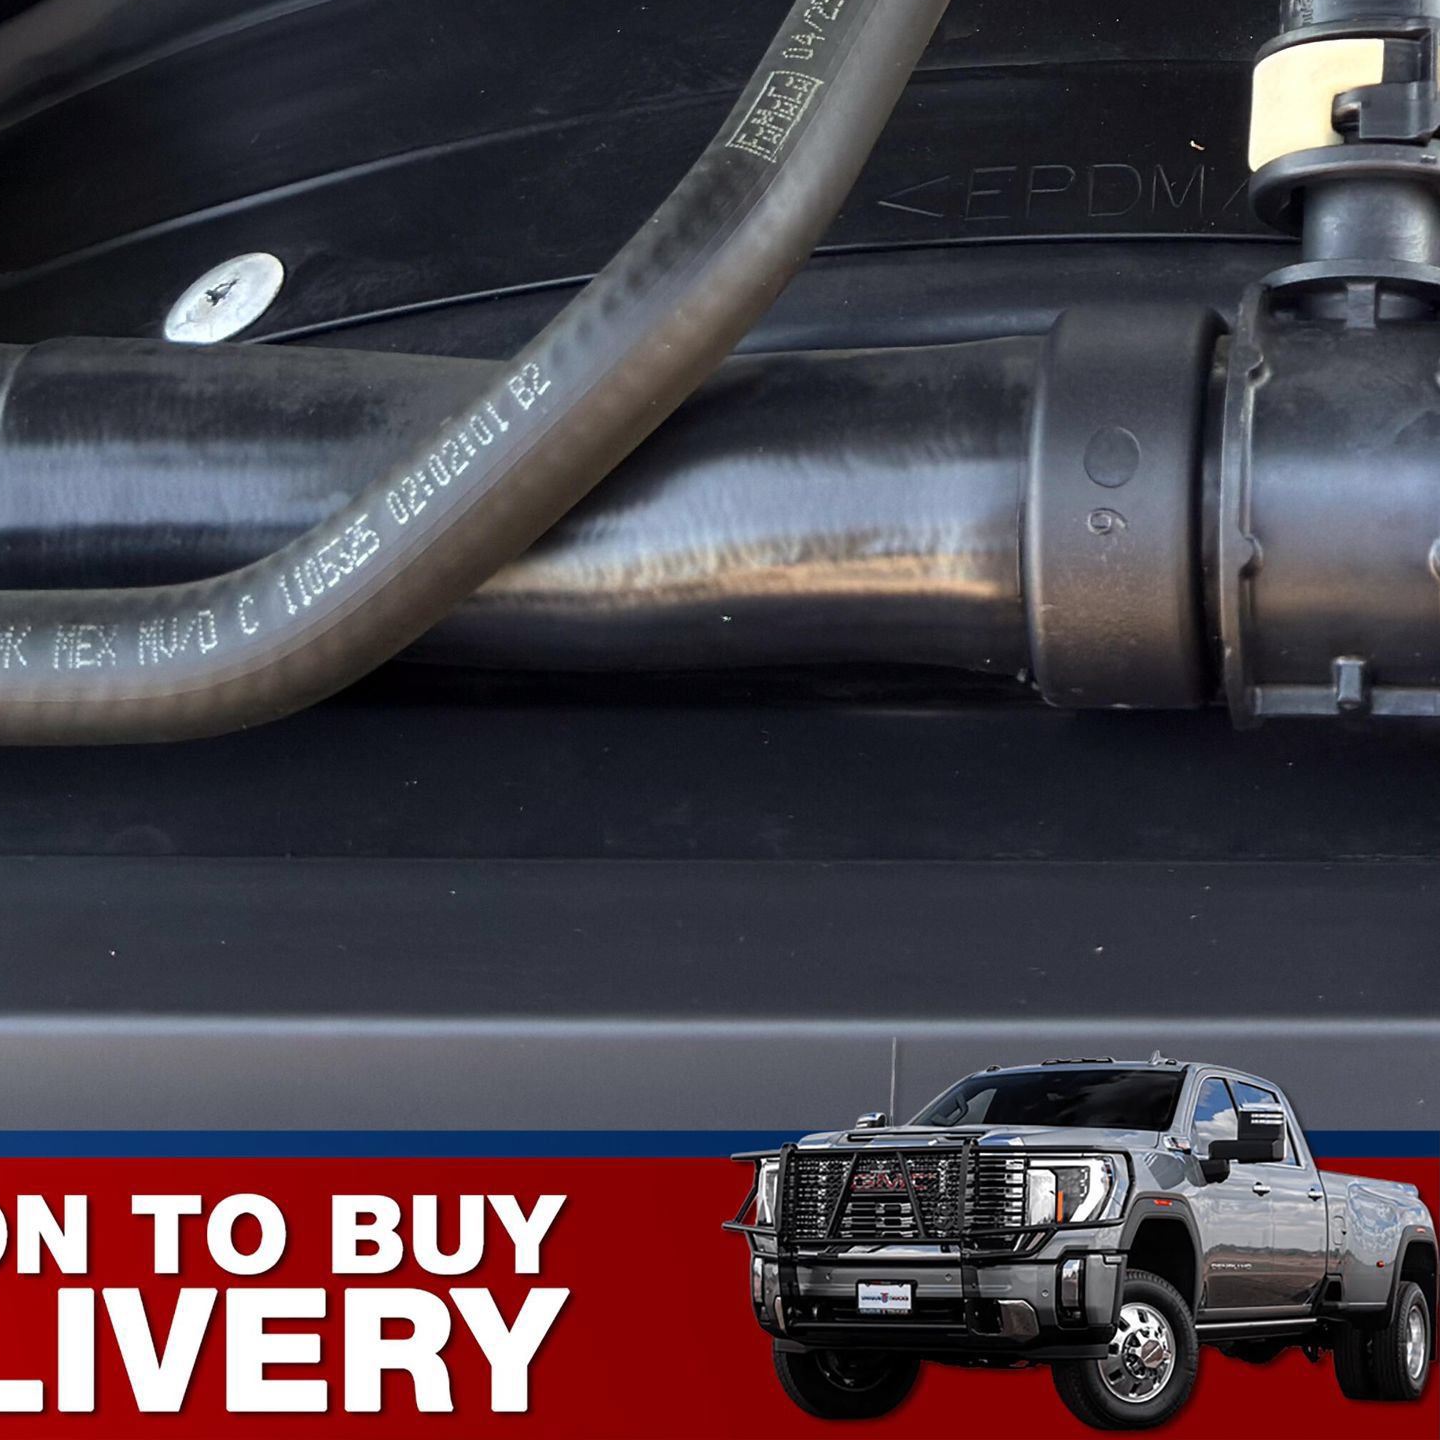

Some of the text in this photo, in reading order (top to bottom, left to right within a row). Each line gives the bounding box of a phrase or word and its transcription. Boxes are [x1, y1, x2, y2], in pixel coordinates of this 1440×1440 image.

[52, 624, 119, 669] MEX
[385, 401, 510, 525] 02:02:01
[508, 362, 553, 411] B2
